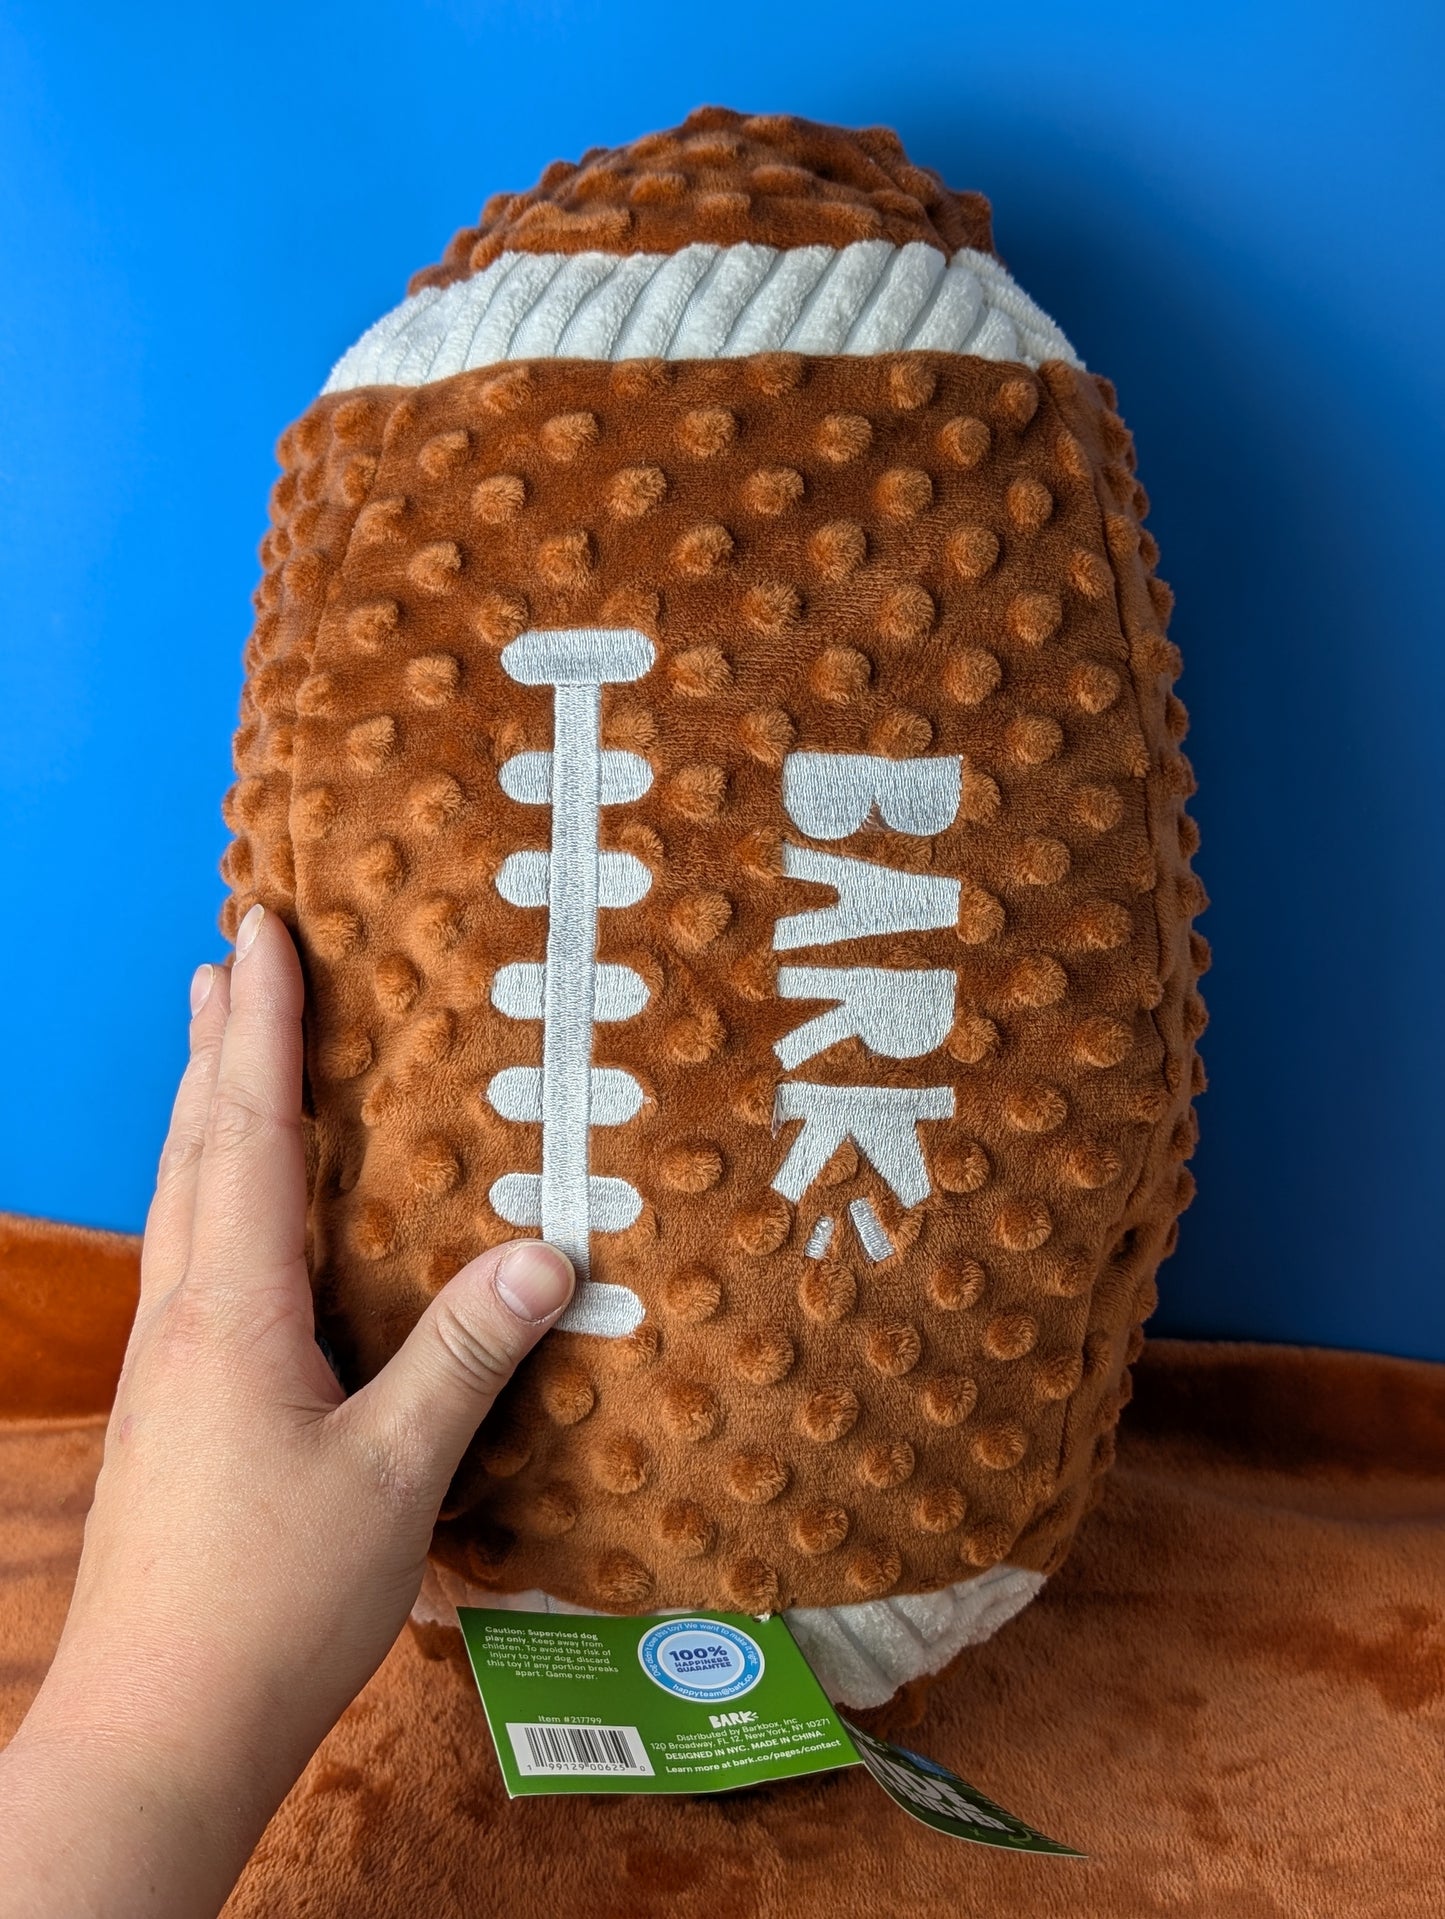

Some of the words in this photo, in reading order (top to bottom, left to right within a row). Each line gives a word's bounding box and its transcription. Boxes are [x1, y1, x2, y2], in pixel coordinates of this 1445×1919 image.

[770, 751, 963, 1209] BARK
[484, 1626, 526, 1636] Caution:
[527, 1629, 579, 1639] Supervised
[580, 1632, 599, 1641] dog
[484, 1634, 504, 1643] play
[506, 1636, 530, 1645] only.
[531, 1637, 555, 1646] Keep
[557, 1640, 579, 1648] away
[581, 1640, 604, 1648] from
[655, 1629, 668, 1639] this
[699, 1624, 720, 1632] want
[721, 1626, 730, 1635] to
[729, 1632, 748, 1647] make
[482, 1643, 525, 1652] children.
[525, 1644, 537, 1652] To
[539, 1646, 564, 1654] avoid
[565, 1647, 581, 1655] the
[583, 1648, 600, 1656] risk
[601, 1649, 611, 1657] of
[489, 1651, 517, 1661] injury
[530, 1654, 551, 1662] your
[576, 1656, 611, 1664] discard
[668, 1645, 728, 1662] 100%
[486, 1659, 505, 1667] this
[506, 1660, 522, 1669] toy
[533, 1662, 549, 1670] any
[551, 1663, 586, 1671] portion
[587, 1664, 620, 1673] breaks
[673, 1656, 730, 1668] HAPPINESS
[675, 1661, 733, 1674] GUARANTEE
[515, 1670, 545, 1678] apart.
[545, 1670, 573, 1679] Game
[574, 1672, 599, 1680] over.
[672, 1673, 754, 1698] happyteam@bark.co
[538, 1715, 561, 1724] Item
[563, 1715, 602, 1725] #217799
[708, 1711, 758, 1729] BARK
[650, 1742, 667, 1751] 120
[668, 1740, 716, 1750] Broadway,
[717, 1737, 730, 1746] FL
[744, 1732, 766, 1741] New
[791, 1723, 805, 1732] NY
[806, 1718, 831, 1728] 10271
[676, 1729, 728, 1742] Distributed
[728, 1728, 741, 1736] by
[783, 1718, 798, 1726] Inc
[665, 1750, 713, 1760] DESIGNED
[714, 1748, 726, 1757] IN
[726, 1744, 750, 1754] NYC.
[751, 1738, 779, 1750] MADE
[779, 1736, 791, 1745] IN
[791, 1730, 826, 1742] CHINA.
[665, 1765, 693, 1773] Learn
[694, 1763, 720, 1772] more
[721, 1760, 732, 1769] at
[732, 1738, 842, 1766] bark.co/pages/contact
[548, 1763, 585, 1771] 99129
[590, 1763, 626, 1771] 00625
